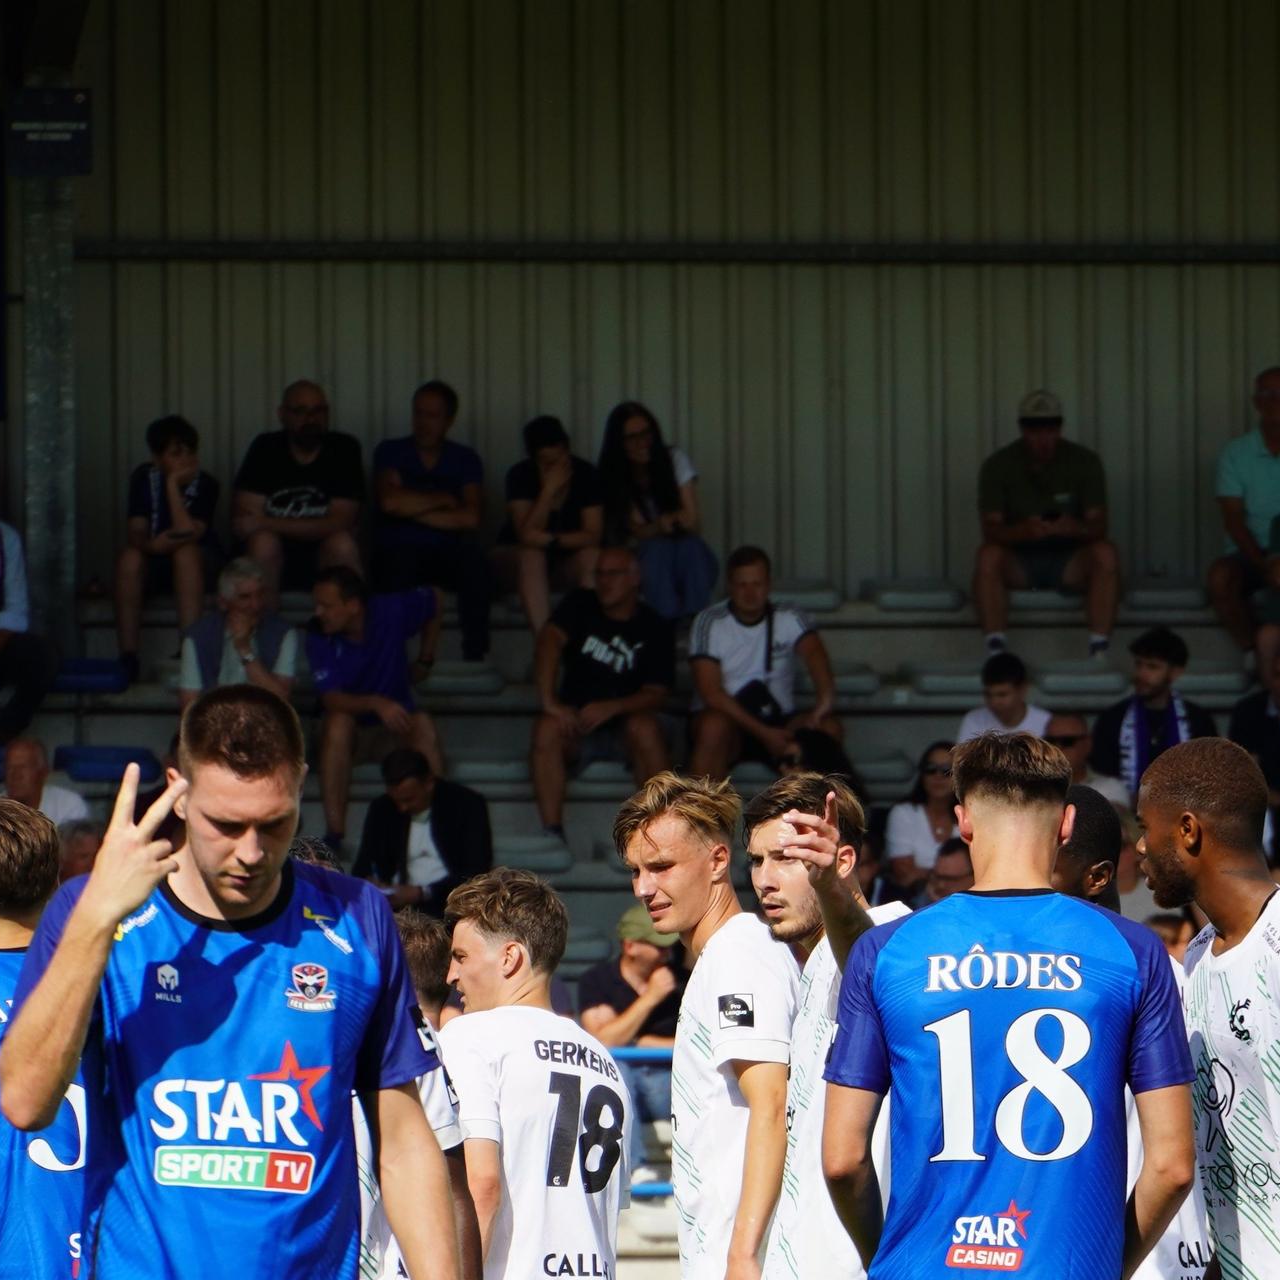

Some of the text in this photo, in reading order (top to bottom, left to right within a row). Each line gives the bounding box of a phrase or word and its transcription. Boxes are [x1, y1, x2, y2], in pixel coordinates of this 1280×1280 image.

[924, 944, 1083, 993] RÔDES
[155, 992, 182, 1003] MILLS
[534, 1040, 619, 1083] GERKENS
[923, 1008, 1094, 1162] 18
[150, 1079, 309, 1146] STAR
[546, 1071, 625, 1194] 18
[160, 1153, 307, 1184] SPORT TV
[952, 1214, 1019, 1247] STAR
[952, 1248, 1017, 1267] CASINO
